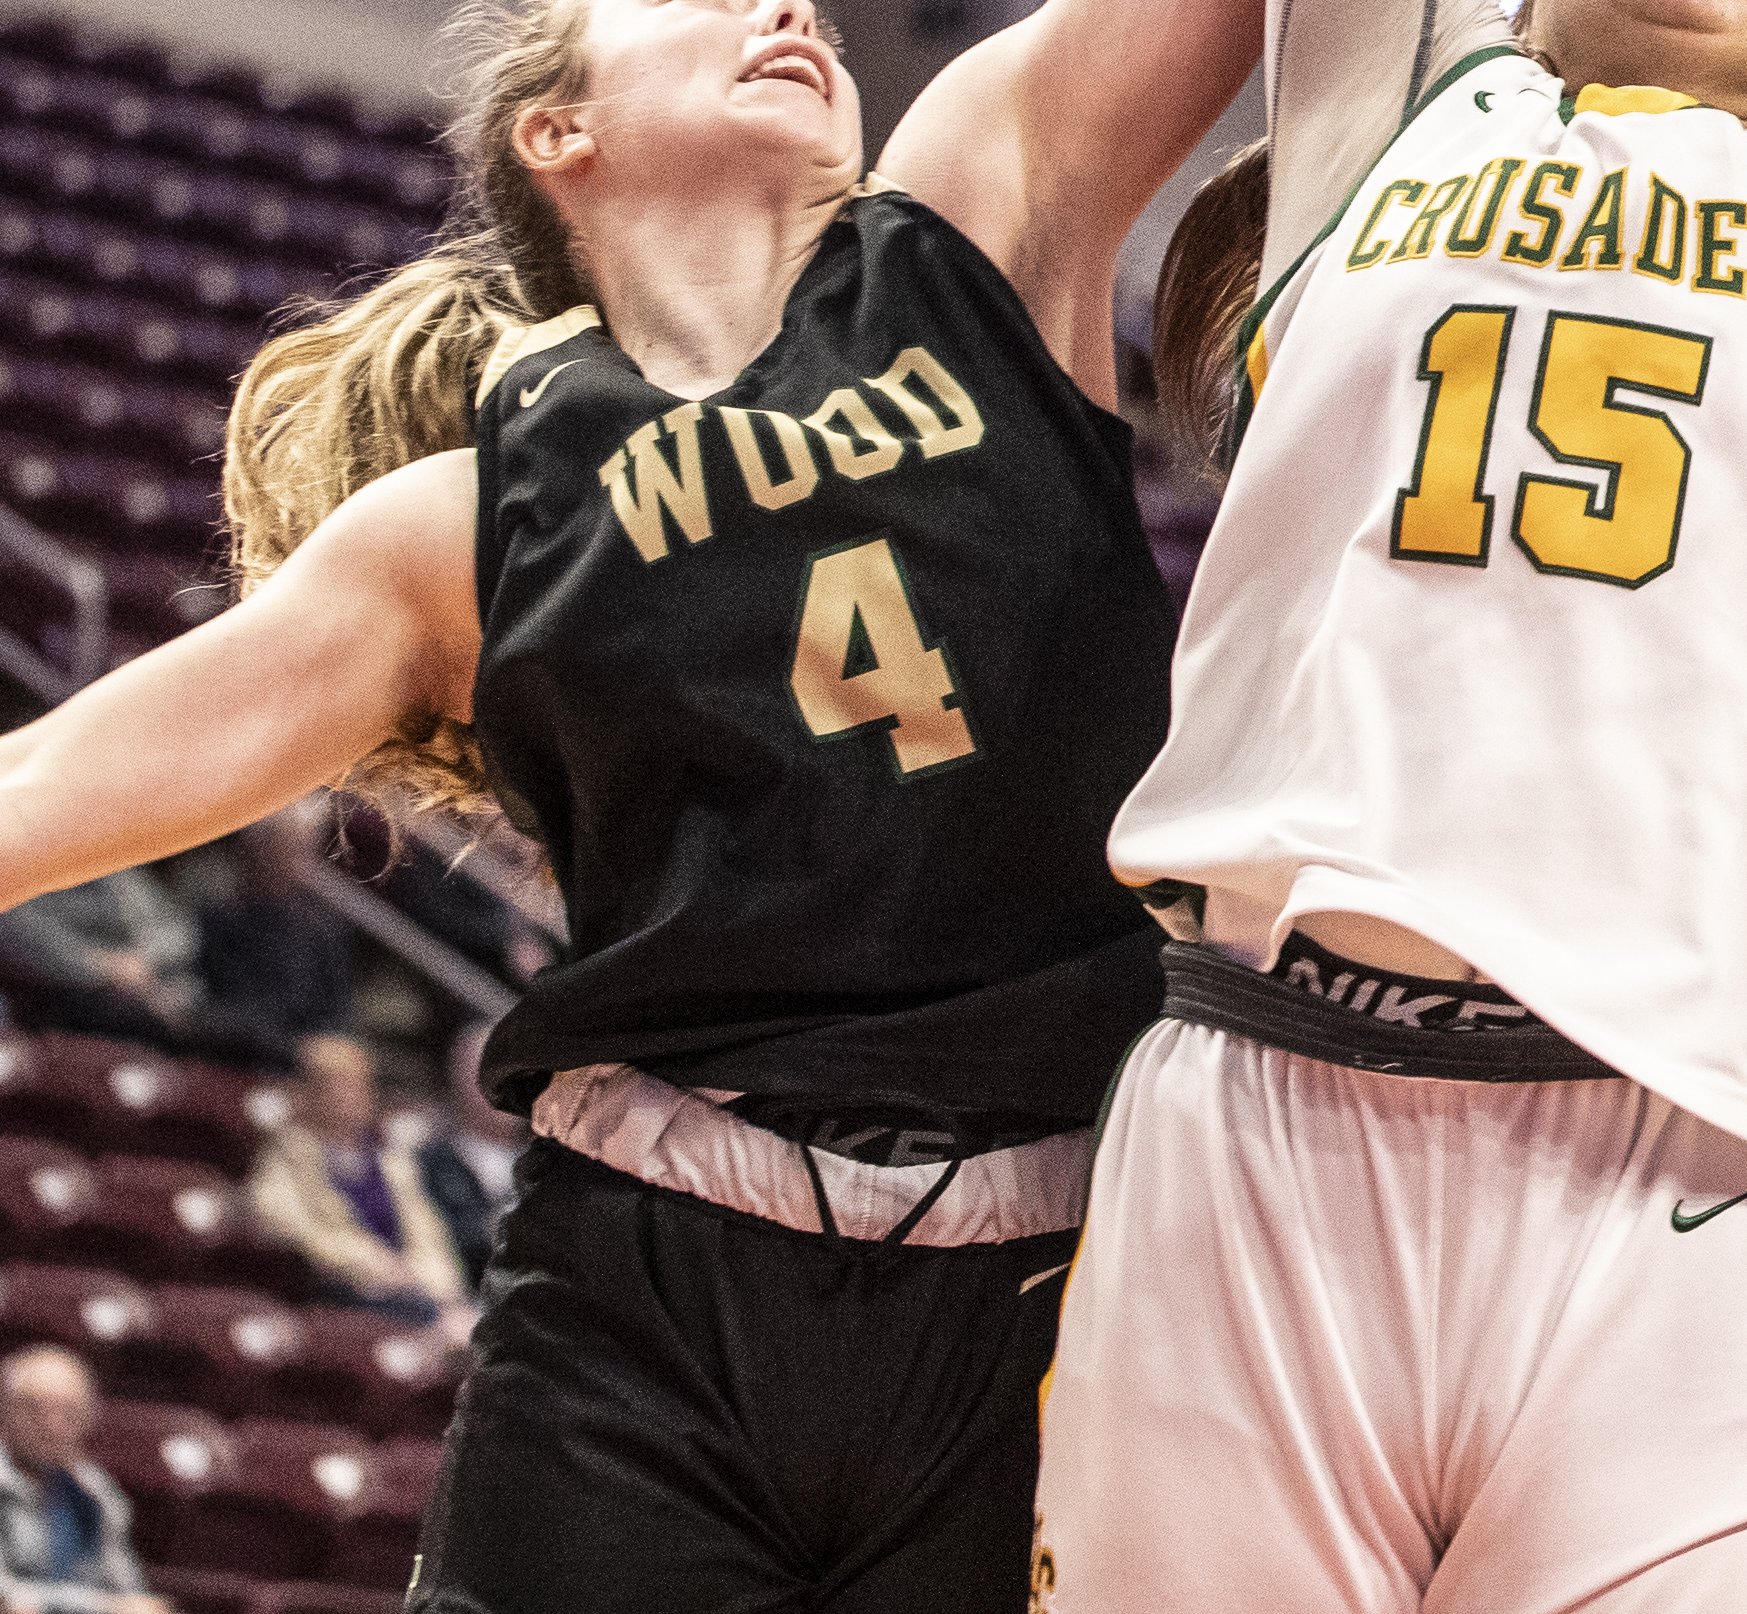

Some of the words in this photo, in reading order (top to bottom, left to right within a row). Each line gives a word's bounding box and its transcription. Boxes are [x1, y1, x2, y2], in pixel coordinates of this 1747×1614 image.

[598, 346, 986, 564] WOOD
[1389, 302, 1715, 591] 15
[790, 532, 982, 780] 4
